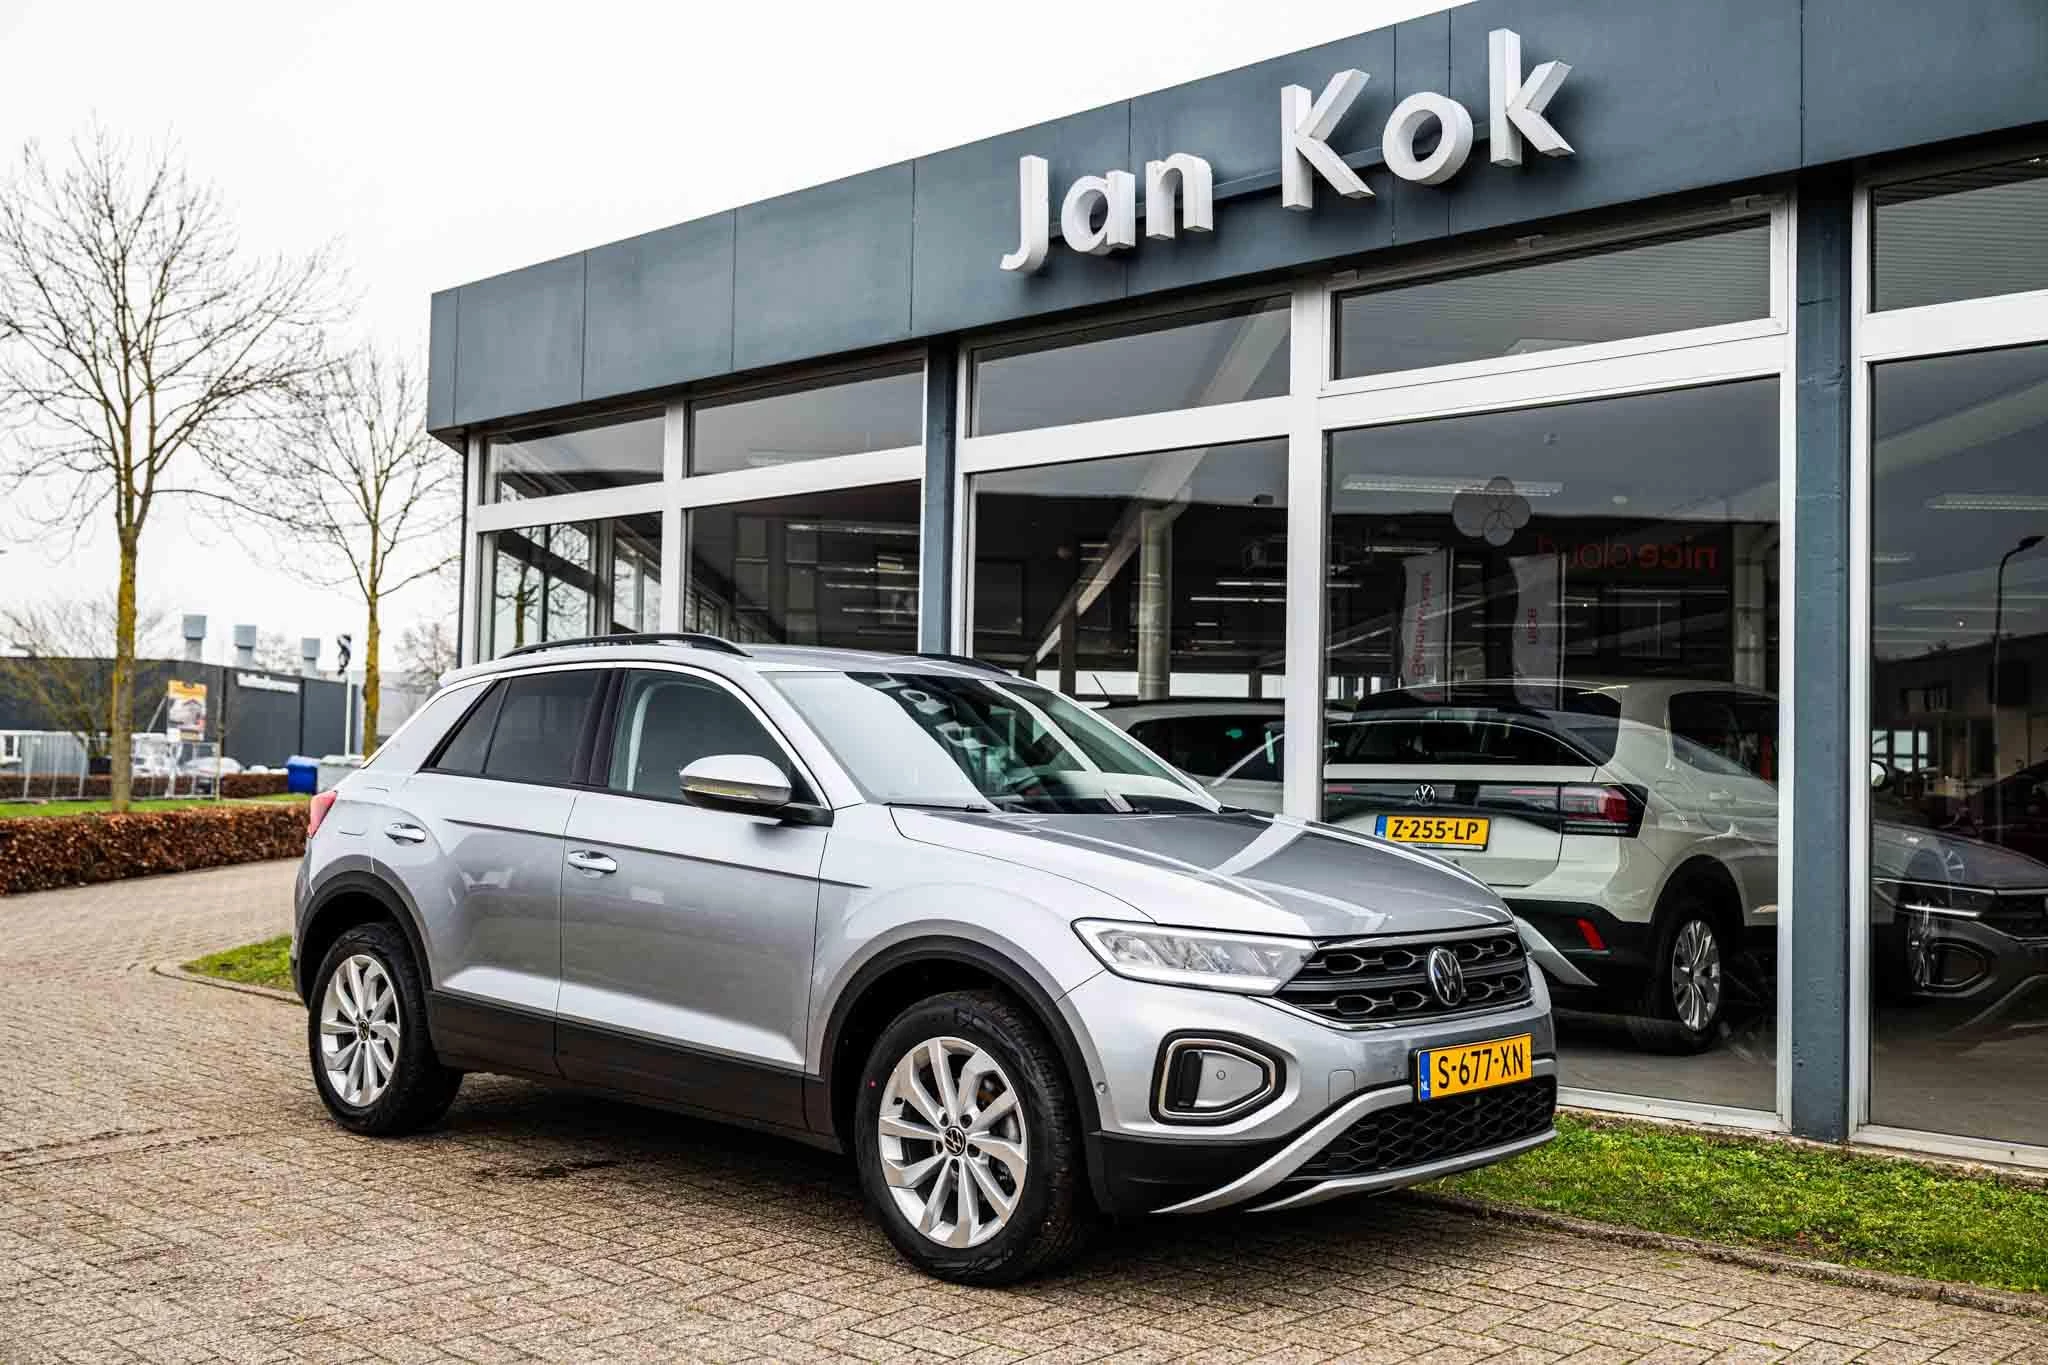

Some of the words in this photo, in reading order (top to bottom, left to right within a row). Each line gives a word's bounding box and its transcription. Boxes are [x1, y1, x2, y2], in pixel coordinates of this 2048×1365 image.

[1000, 152, 1213, 275] Jan
[1280, 28, 1575, 211] Kok
[1392, 819, 1479, 840] Z-255-LP
[1438, 1042, 1524, 1089] S-677-XN
